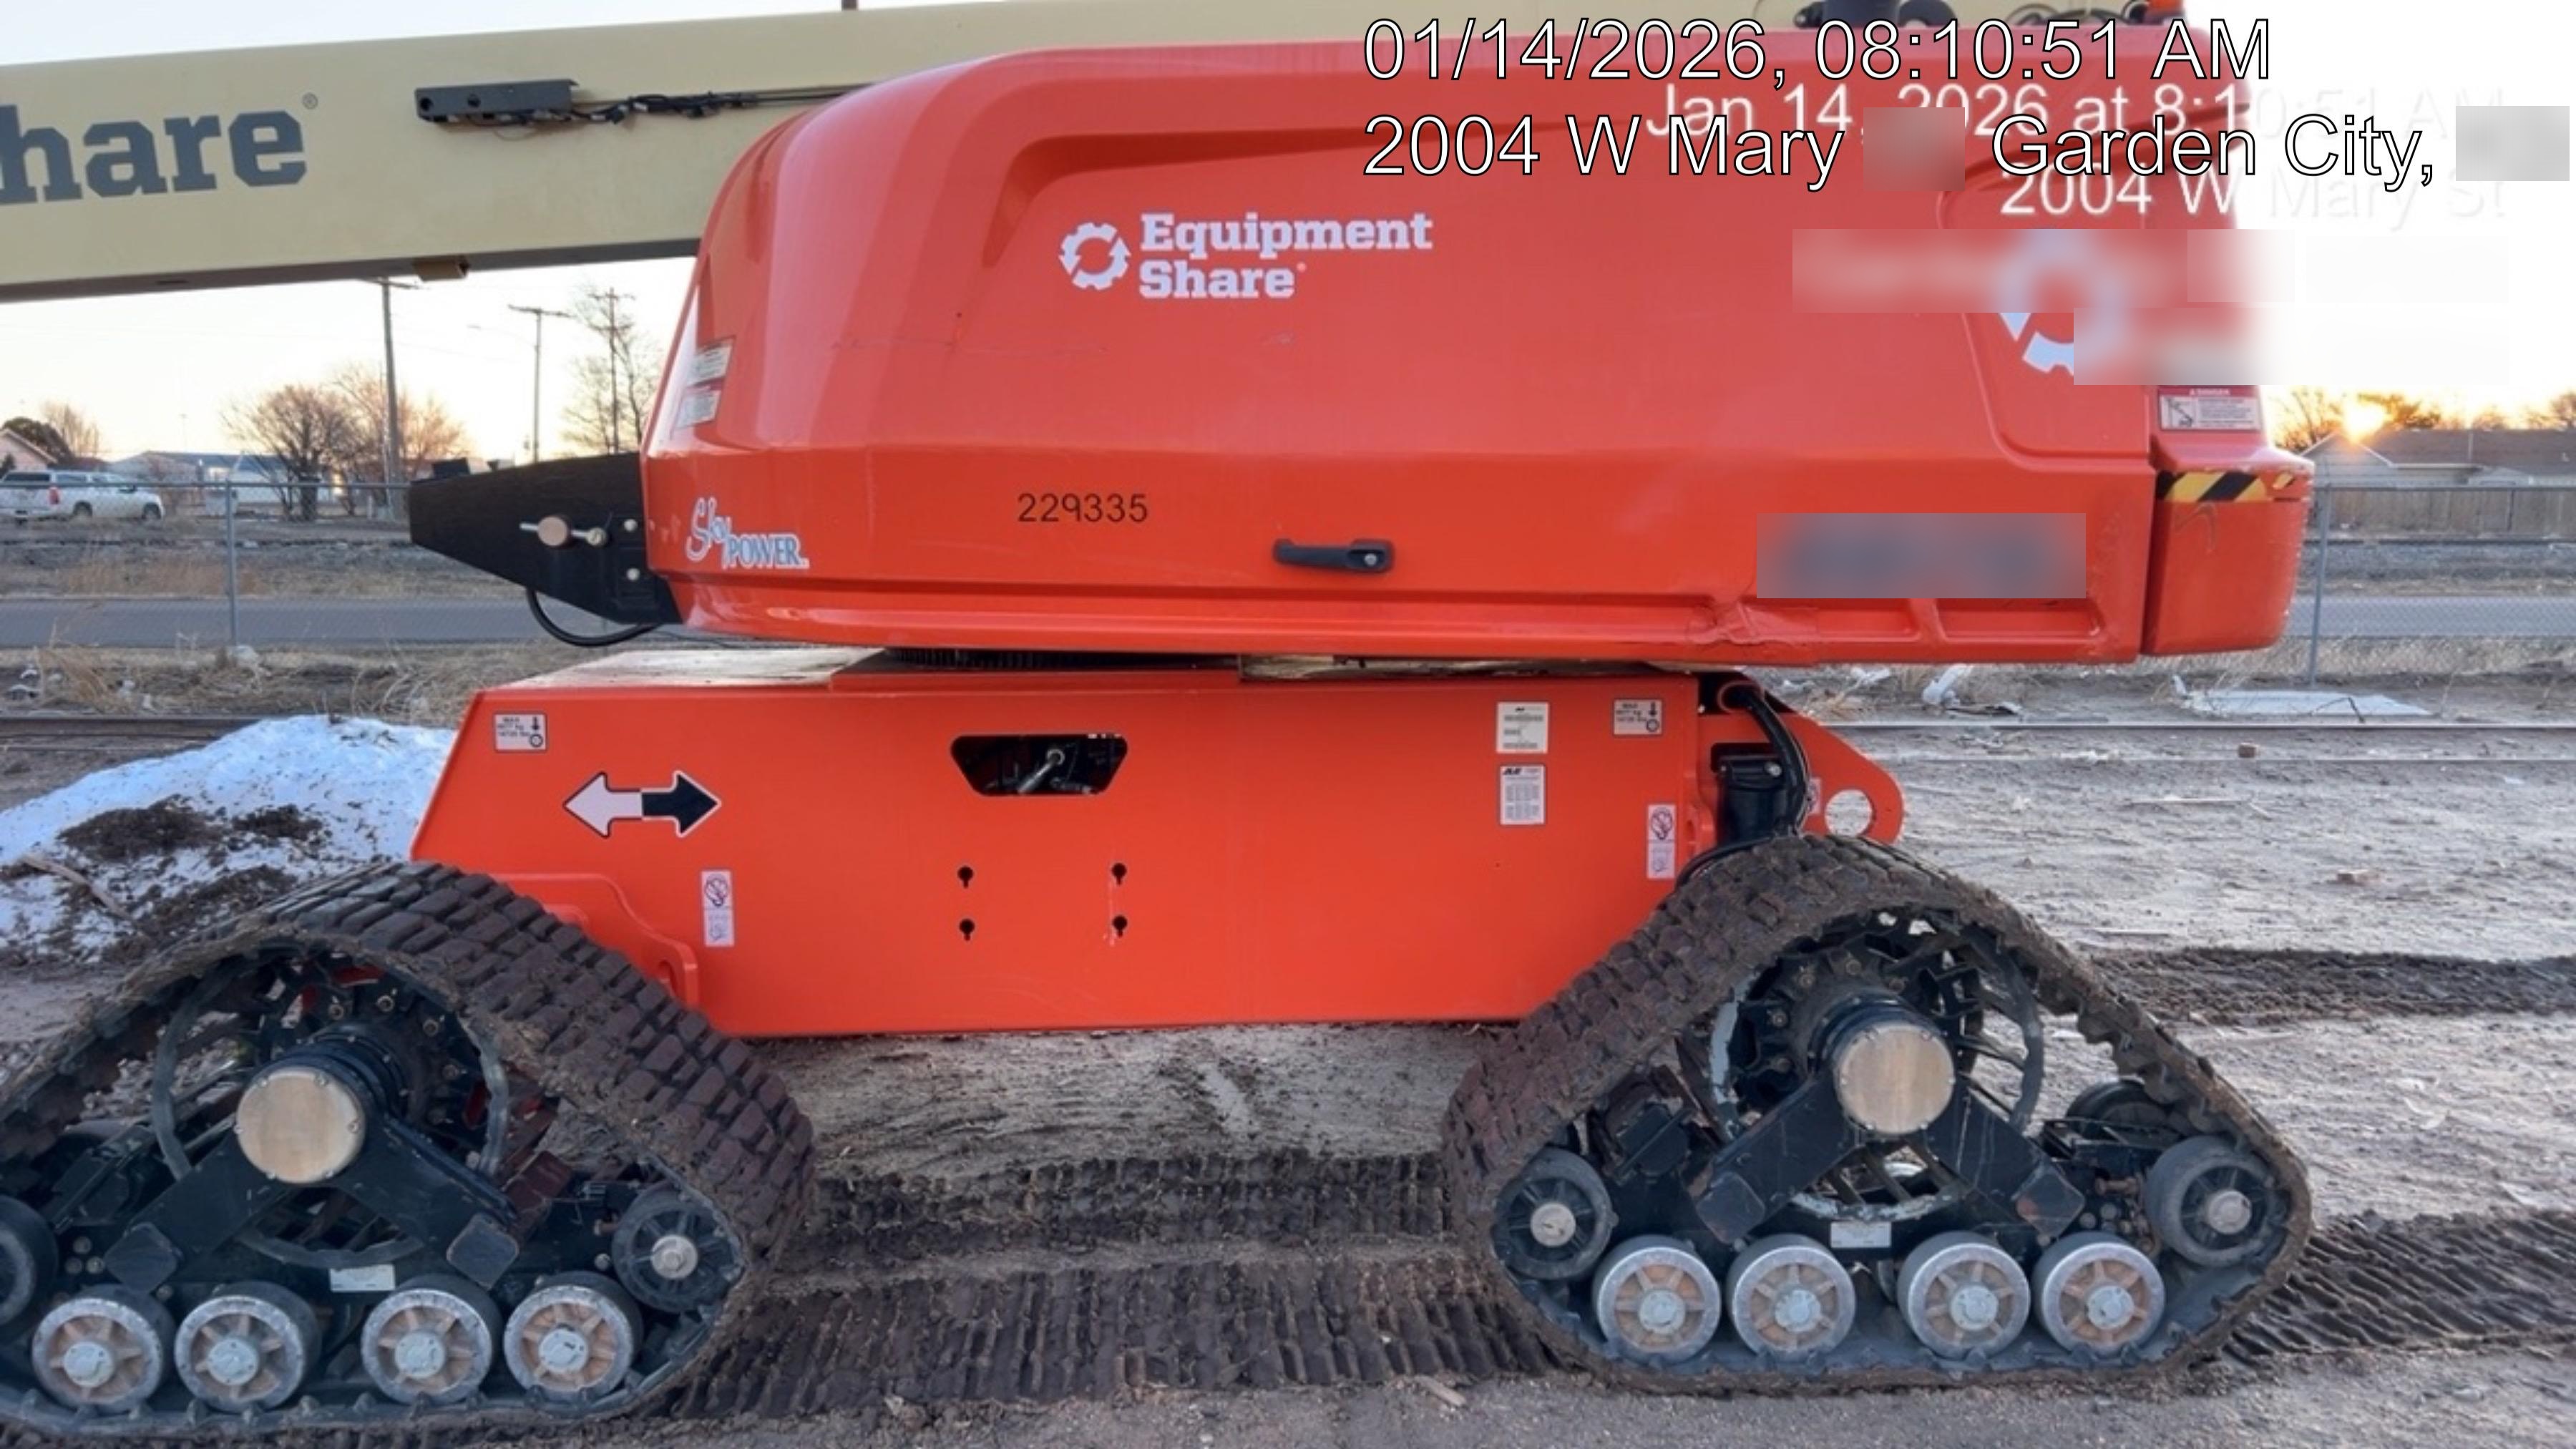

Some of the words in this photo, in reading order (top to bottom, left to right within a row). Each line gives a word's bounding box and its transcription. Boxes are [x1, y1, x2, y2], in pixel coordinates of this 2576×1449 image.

[1140, 211, 1433, 260] Equipment
[1139, 260, 1294, 298] Share
[1018, 493, 1148, 522] 229335
